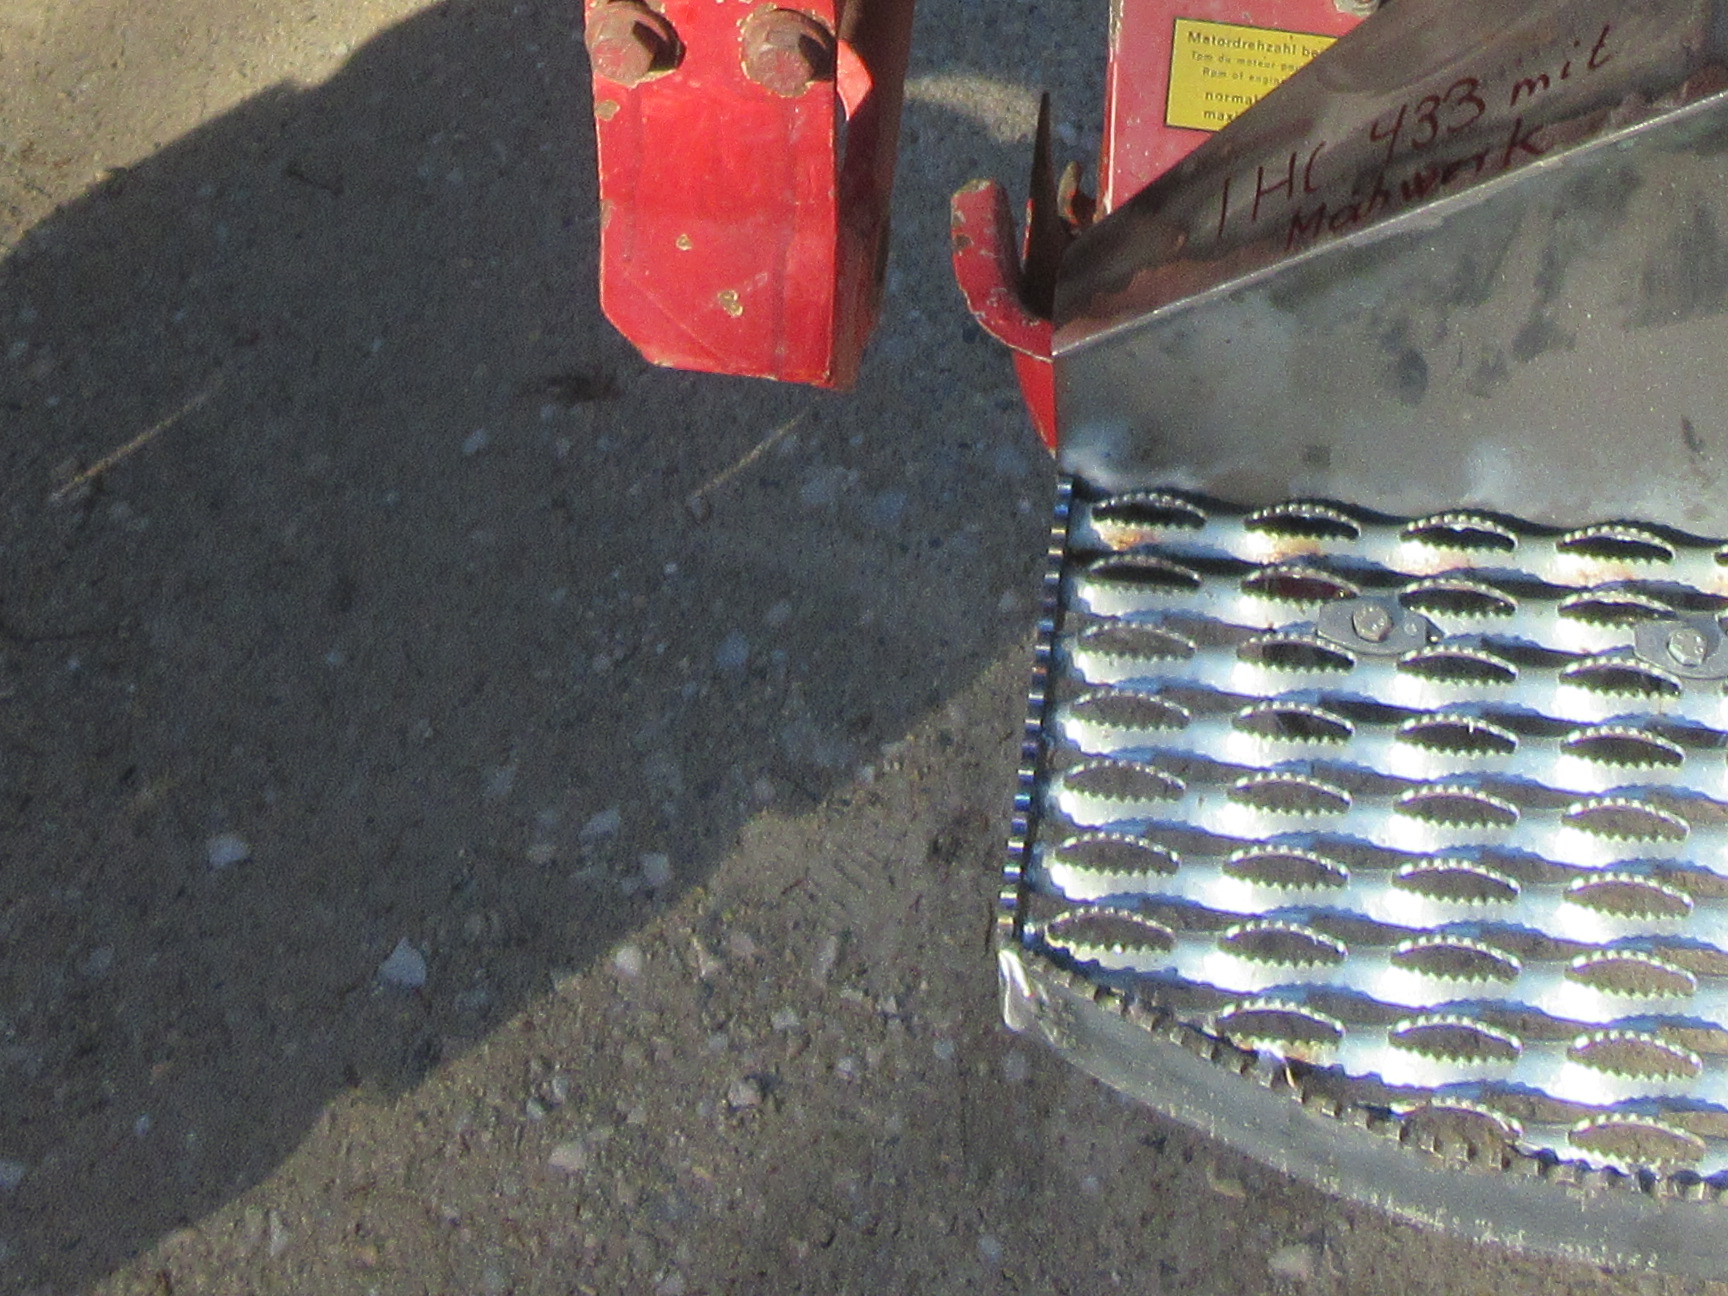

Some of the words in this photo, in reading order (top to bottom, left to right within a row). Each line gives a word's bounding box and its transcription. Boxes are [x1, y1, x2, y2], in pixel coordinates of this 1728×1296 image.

[1187, 30, 1297, 56] Motordrehzahl
[1202, 66, 1227, 79] Rpm
[1232, 71, 1244, 81] of
[1370, 77, 1486, 173] 433
[1509, 23, 1613, 107] mit
